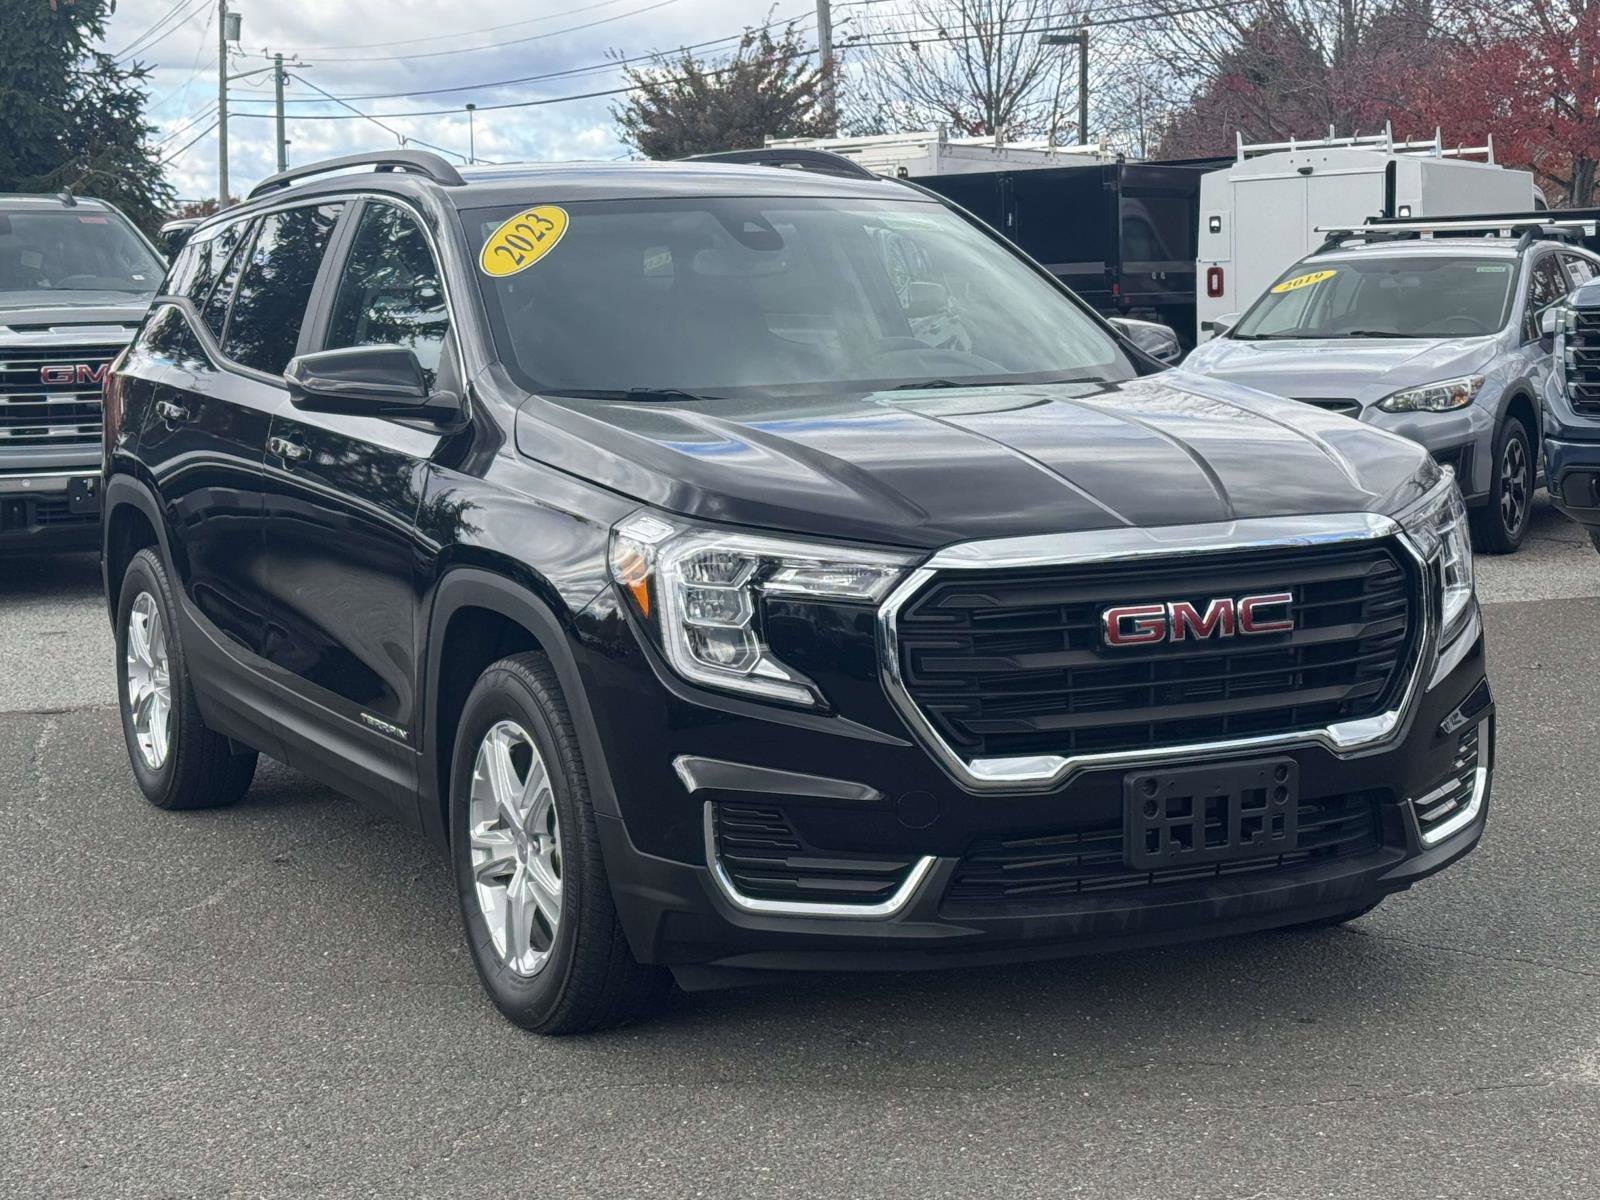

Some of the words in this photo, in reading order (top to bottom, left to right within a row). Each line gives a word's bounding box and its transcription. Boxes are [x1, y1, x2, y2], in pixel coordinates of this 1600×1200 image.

[494, 213, 555, 266] 2023
[41, 364, 109, 384] GM
[1103, 592, 1294, 646] GMC
